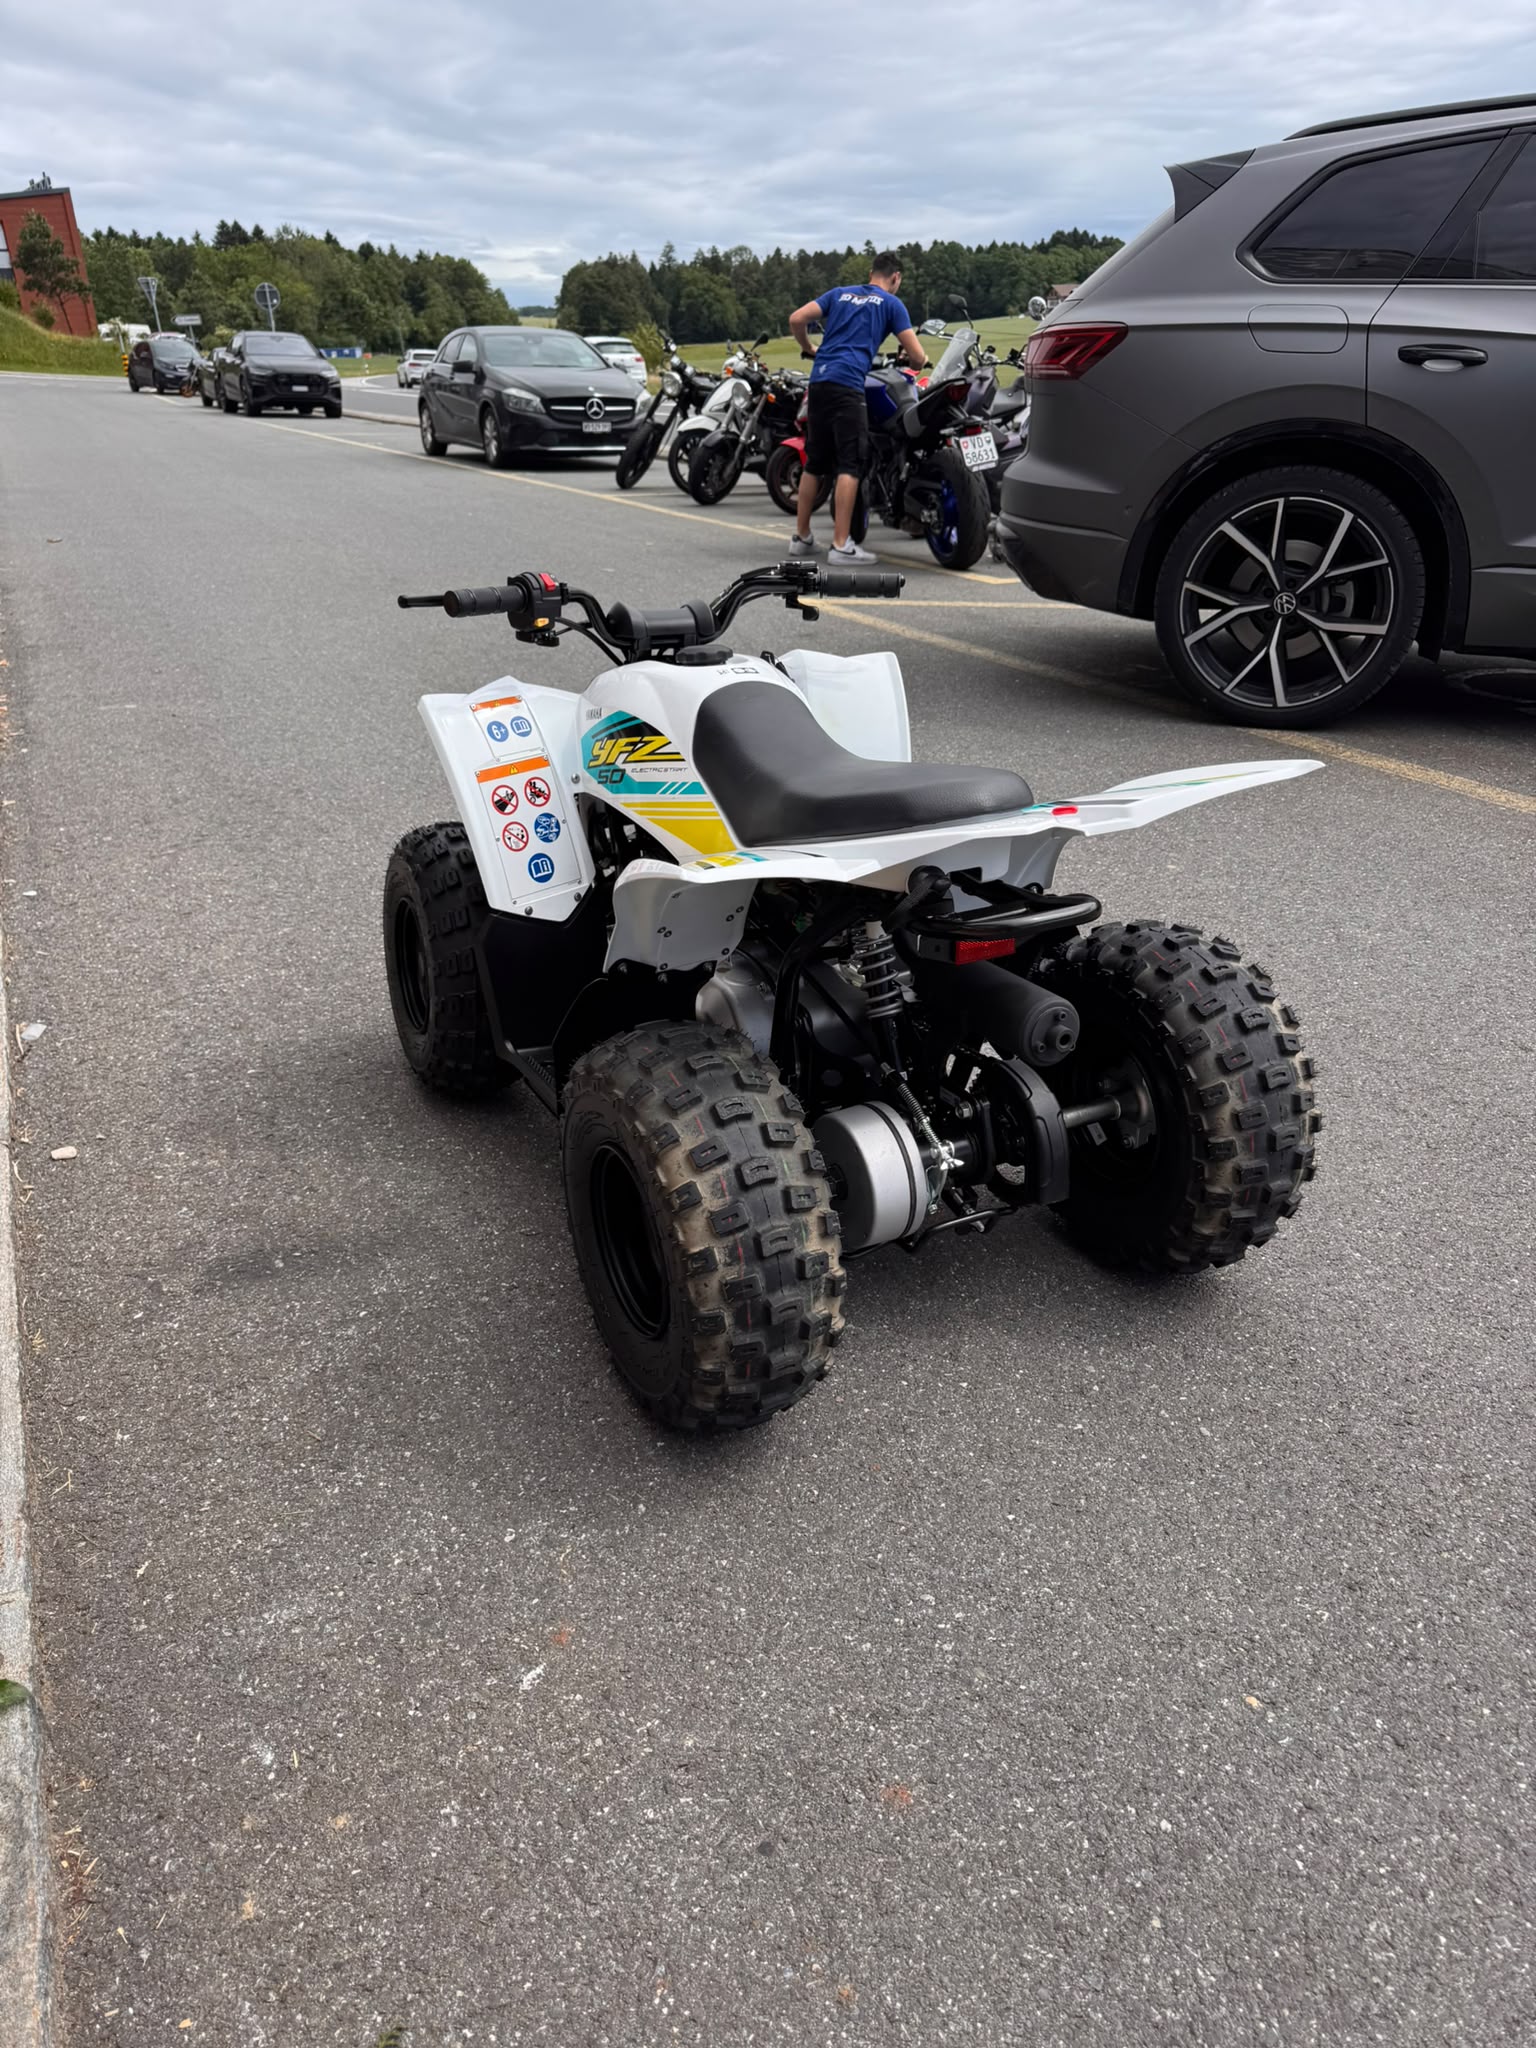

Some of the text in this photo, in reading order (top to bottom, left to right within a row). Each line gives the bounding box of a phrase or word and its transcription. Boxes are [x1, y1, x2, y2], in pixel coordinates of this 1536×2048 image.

[970, 436, 984, 449] VD
[965, 447, 996, 465] 58631
[587, 736, 686, 768] YFZ
[597, 769, 626, 784] 50
